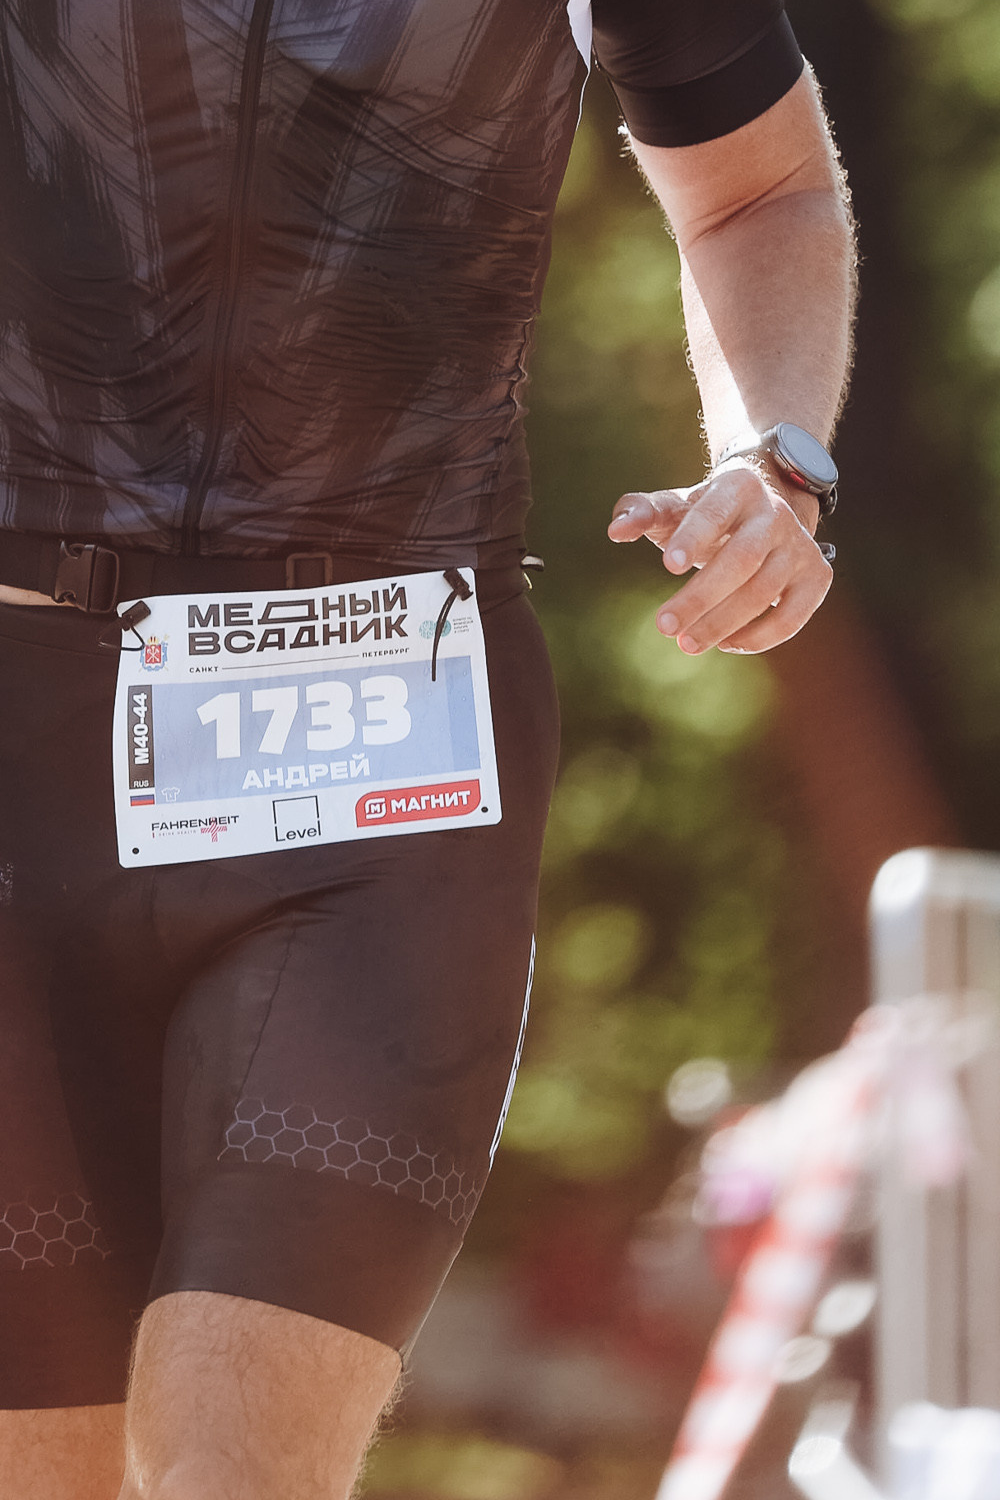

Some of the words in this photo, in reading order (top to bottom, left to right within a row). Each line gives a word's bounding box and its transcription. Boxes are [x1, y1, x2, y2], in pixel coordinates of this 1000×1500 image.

[187, 583, 408, 628] МЕДНЫЙ
[188, 613, 409, 656] ВСАДНИК
[362, 647, 410, 658] ПЕТЕРБУРГ
[196, 674, 412, 759] 1733
[242, 753, 371, 790] АНДРЕЙ
[133, 780, 150, 788] RUS
[390, 790, 471, 814] МАГНИТ
[151, 815, 240, 831] FAHRENHEIT
[274, 824, 322, 842] Level
